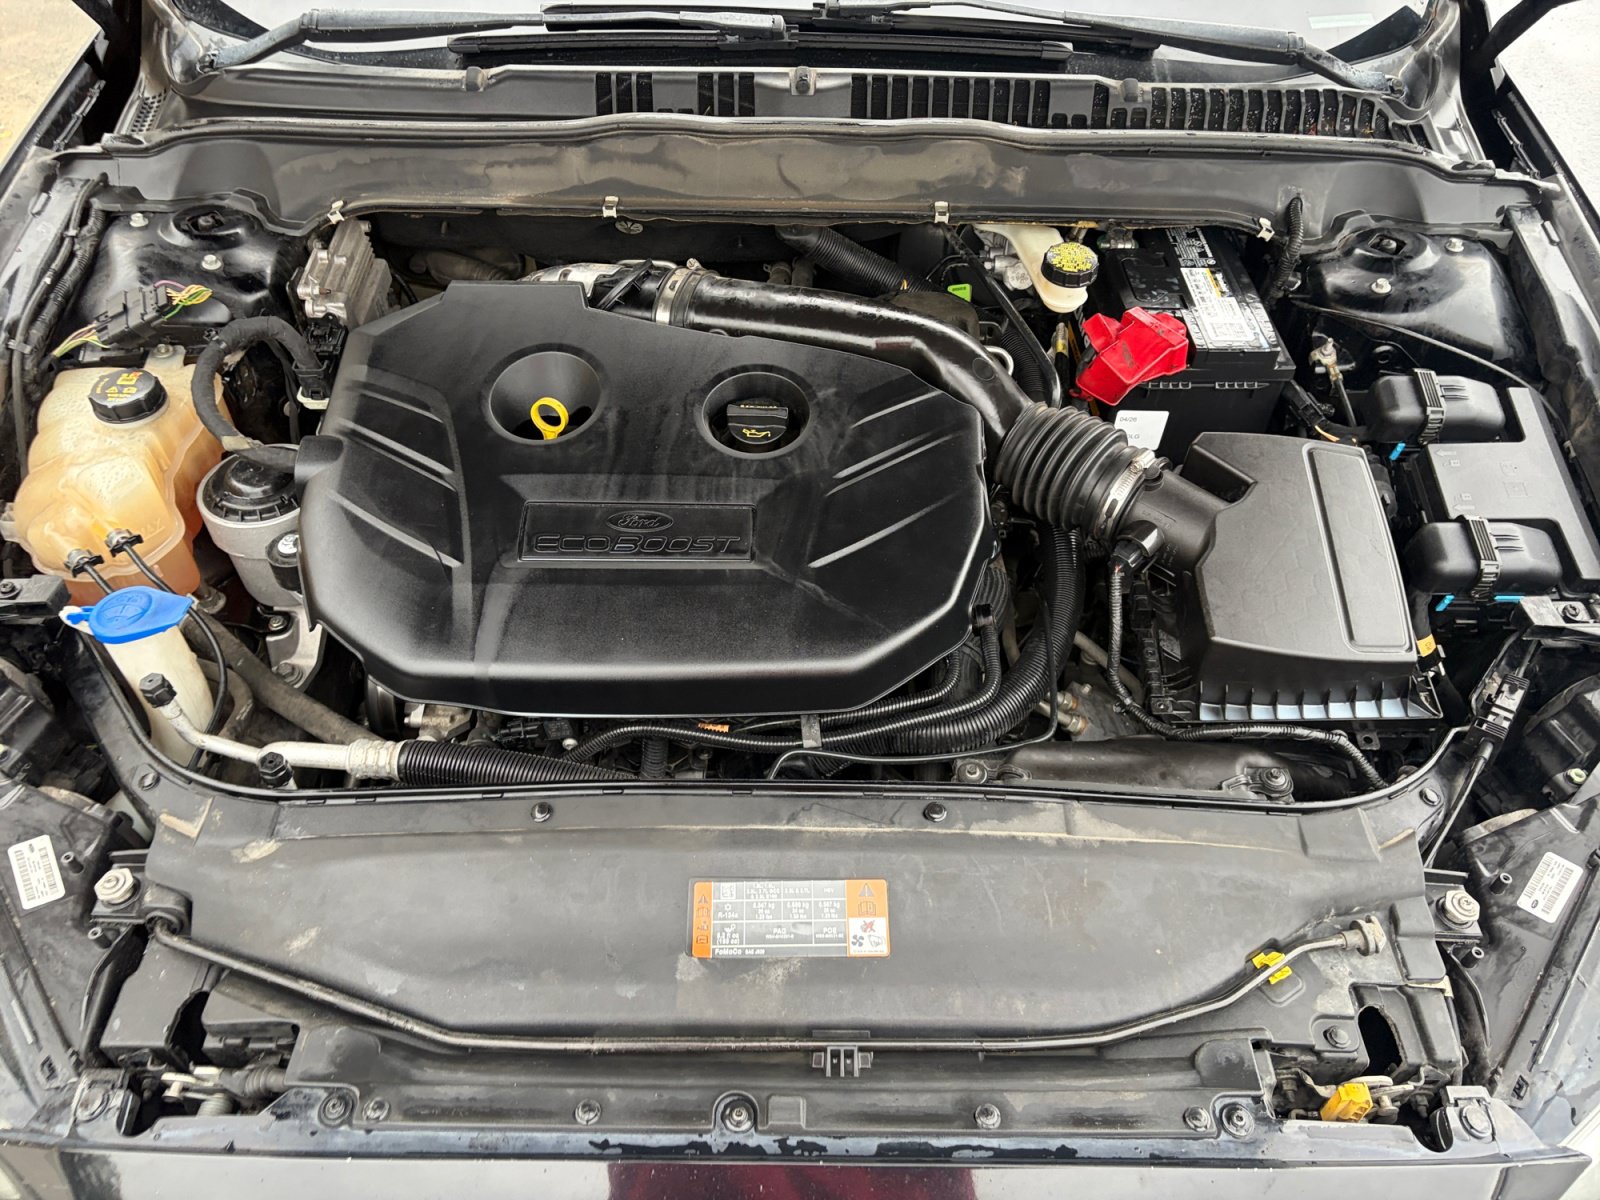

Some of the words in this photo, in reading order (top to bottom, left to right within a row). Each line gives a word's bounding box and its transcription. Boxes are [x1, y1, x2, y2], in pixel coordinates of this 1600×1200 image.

[617, 513, 660, 529] Ford
[534, 534, 741, 554] ECOBOOST
[718, 911, 738, 919] R-134a
